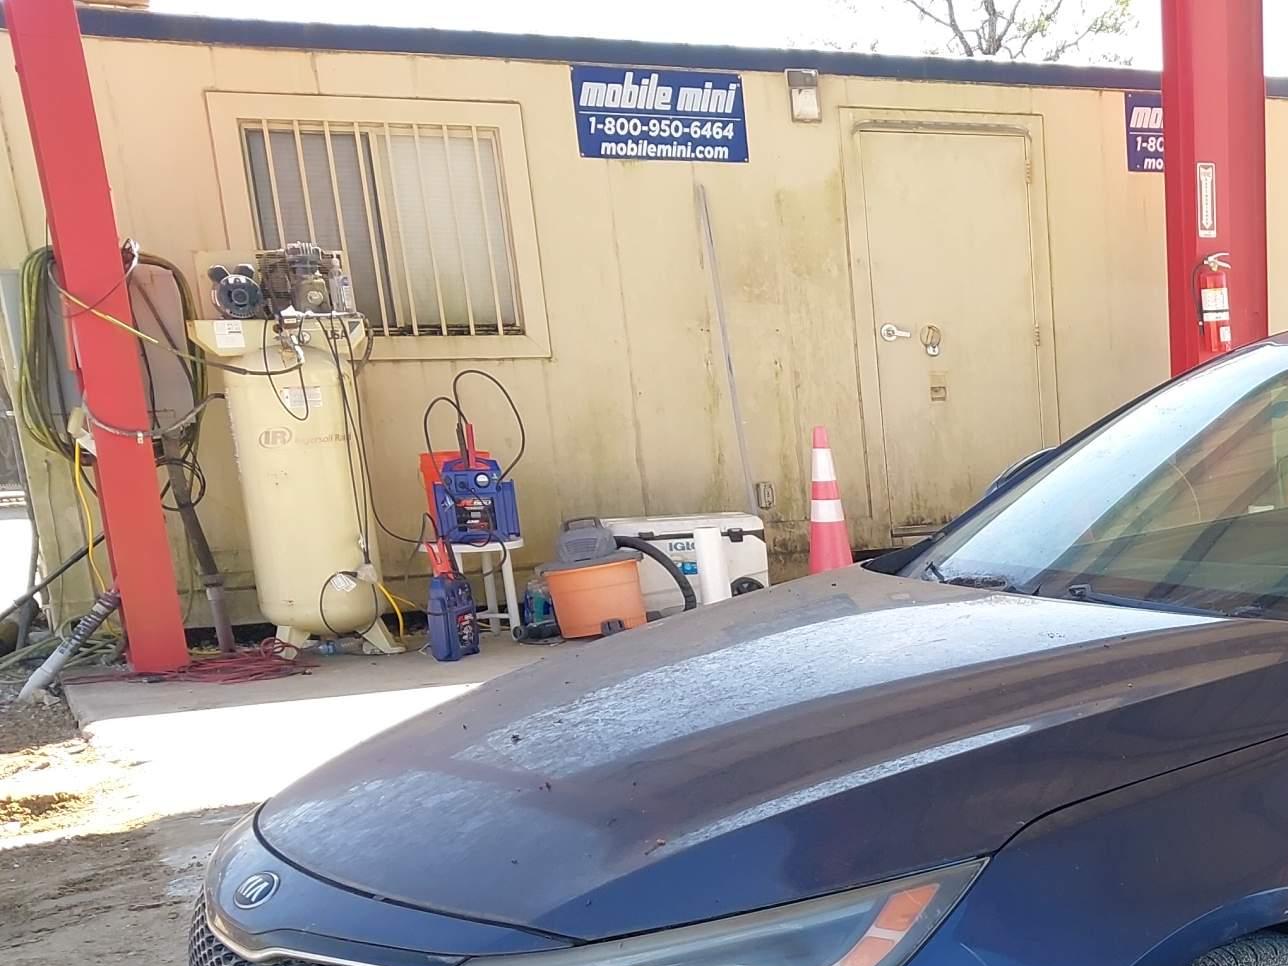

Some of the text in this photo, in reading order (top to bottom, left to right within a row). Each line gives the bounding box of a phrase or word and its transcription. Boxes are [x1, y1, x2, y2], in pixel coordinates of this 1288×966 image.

[579, 71, 737, 114] mobile mini
[588, 116, 735, 140] 1-800-950-6464
[1130, 107, 1164, 129] mo
[600, 139, 730, 160] mobilemini.com
